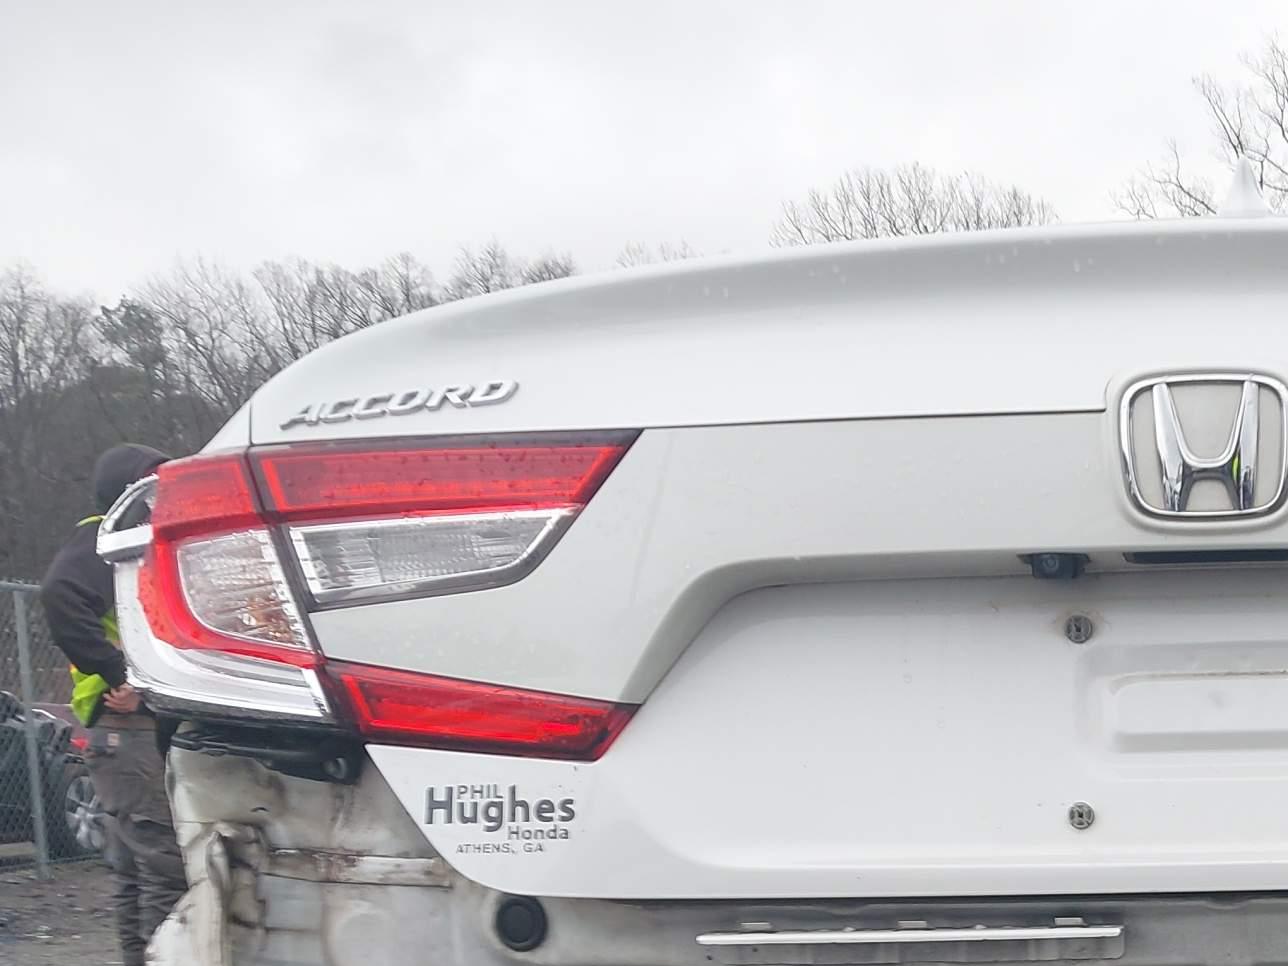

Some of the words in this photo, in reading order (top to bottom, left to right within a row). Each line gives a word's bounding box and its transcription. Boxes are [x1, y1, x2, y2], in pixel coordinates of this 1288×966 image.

[279, 379, 519, 431] ACCORD
[456, 784, 504, 799] PHIL
[424, 784, 576, 832] Hughes
[507, 825, 570, 840] Honda
[456, 842, 516, 855] ATHENS,
[523, 841, 545, 854] GA
